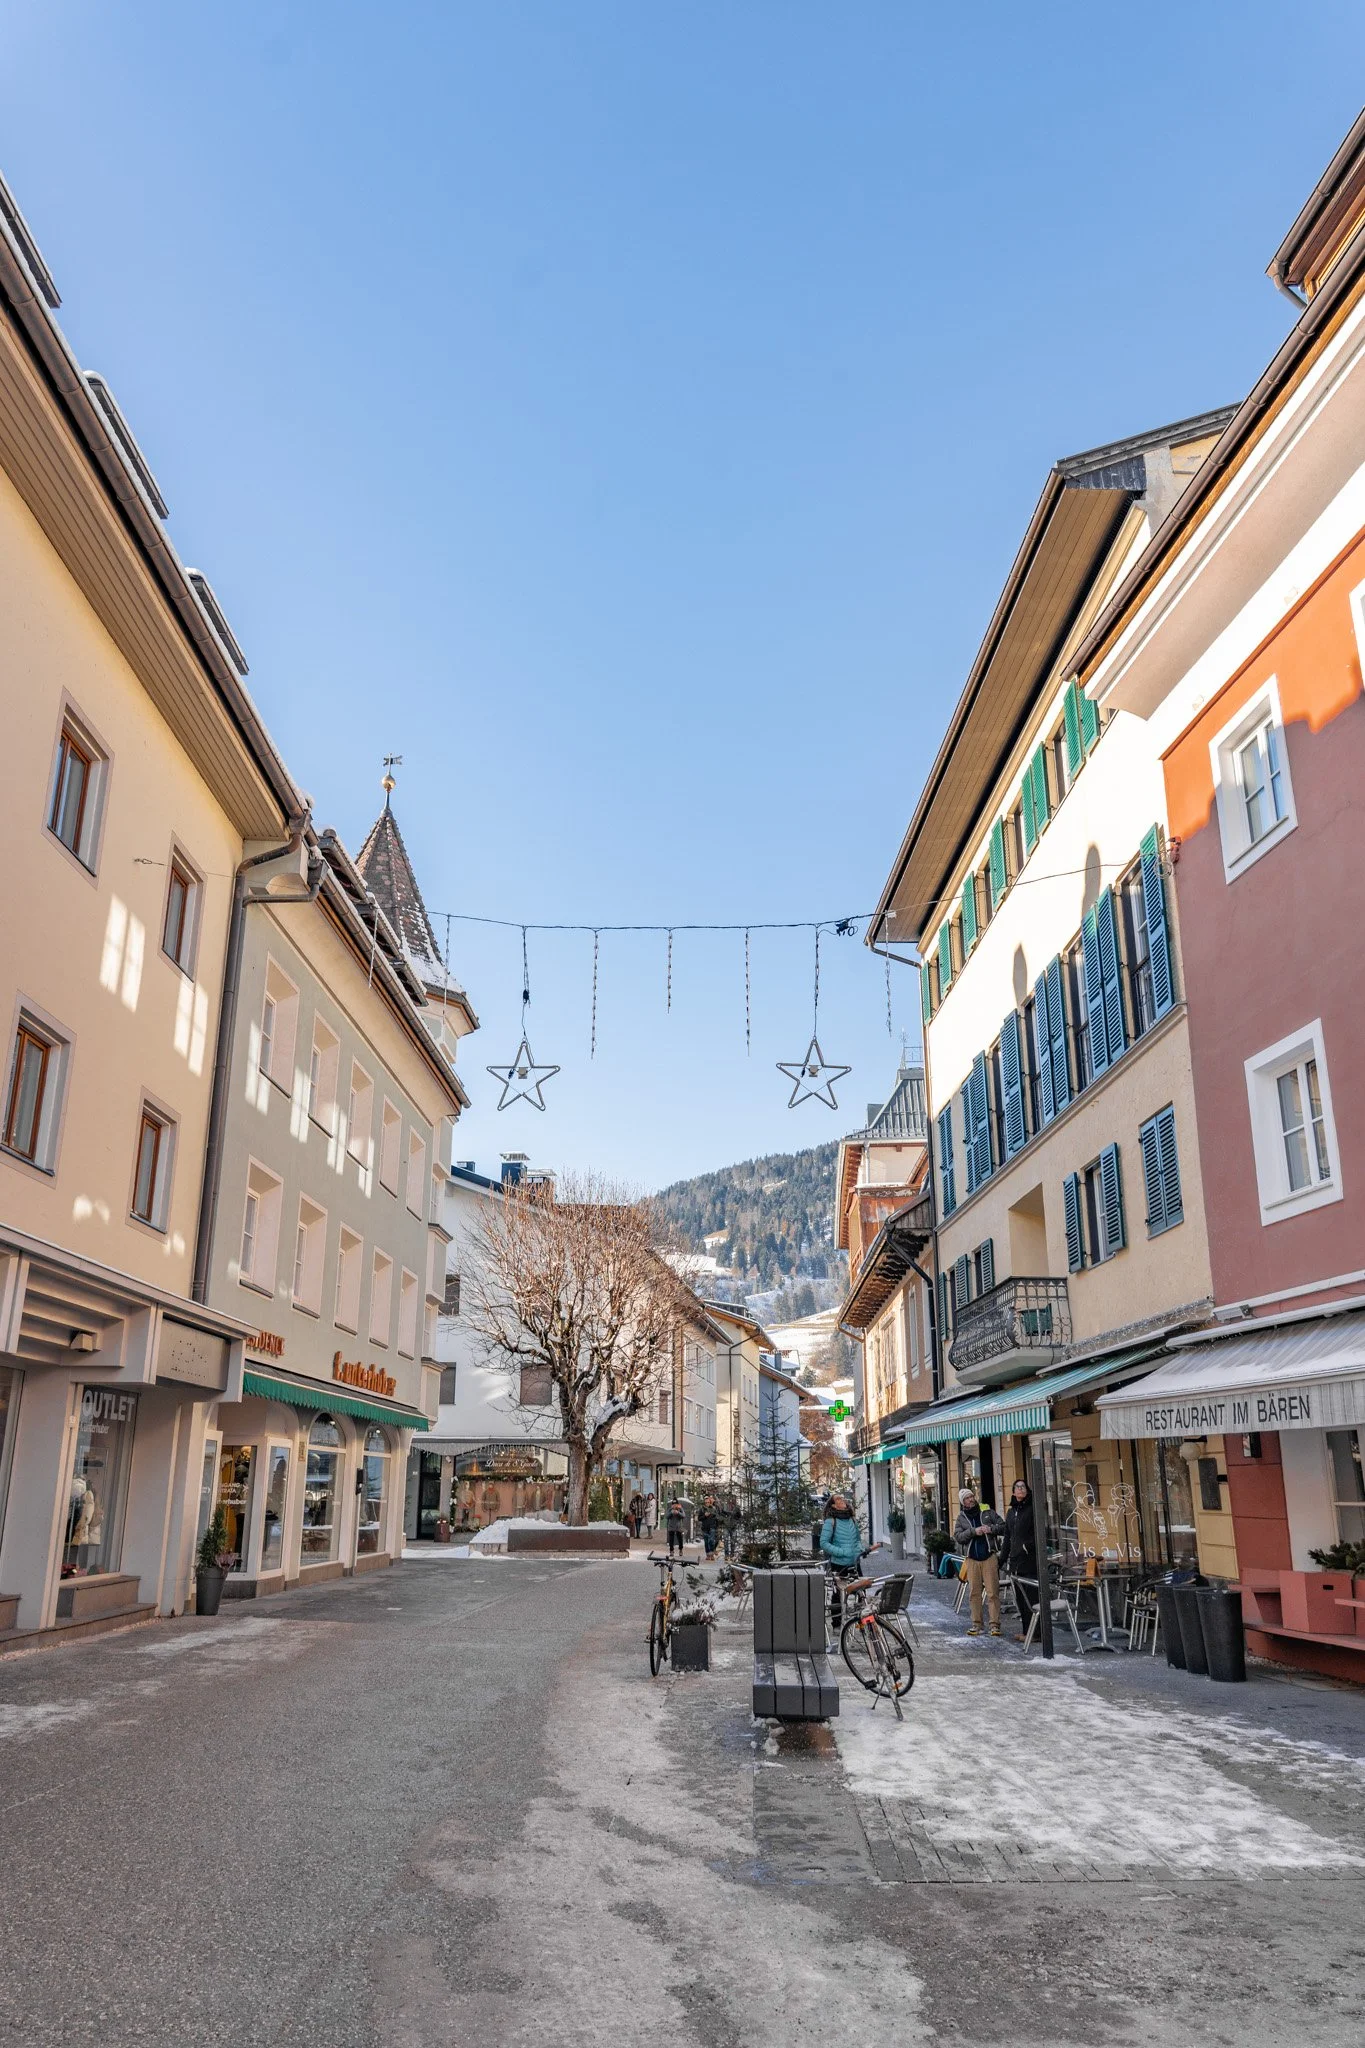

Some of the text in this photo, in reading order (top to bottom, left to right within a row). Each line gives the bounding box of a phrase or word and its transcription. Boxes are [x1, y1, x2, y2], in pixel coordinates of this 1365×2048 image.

[83, 1390, 136, 1422] OUTLET
[1146, 1393, 1311, 1431] RESTAURANT IM BÄREN
[1070, 1542, 1096, 1558] Vis
[1115, 1542, 1141, 1558] Vis
